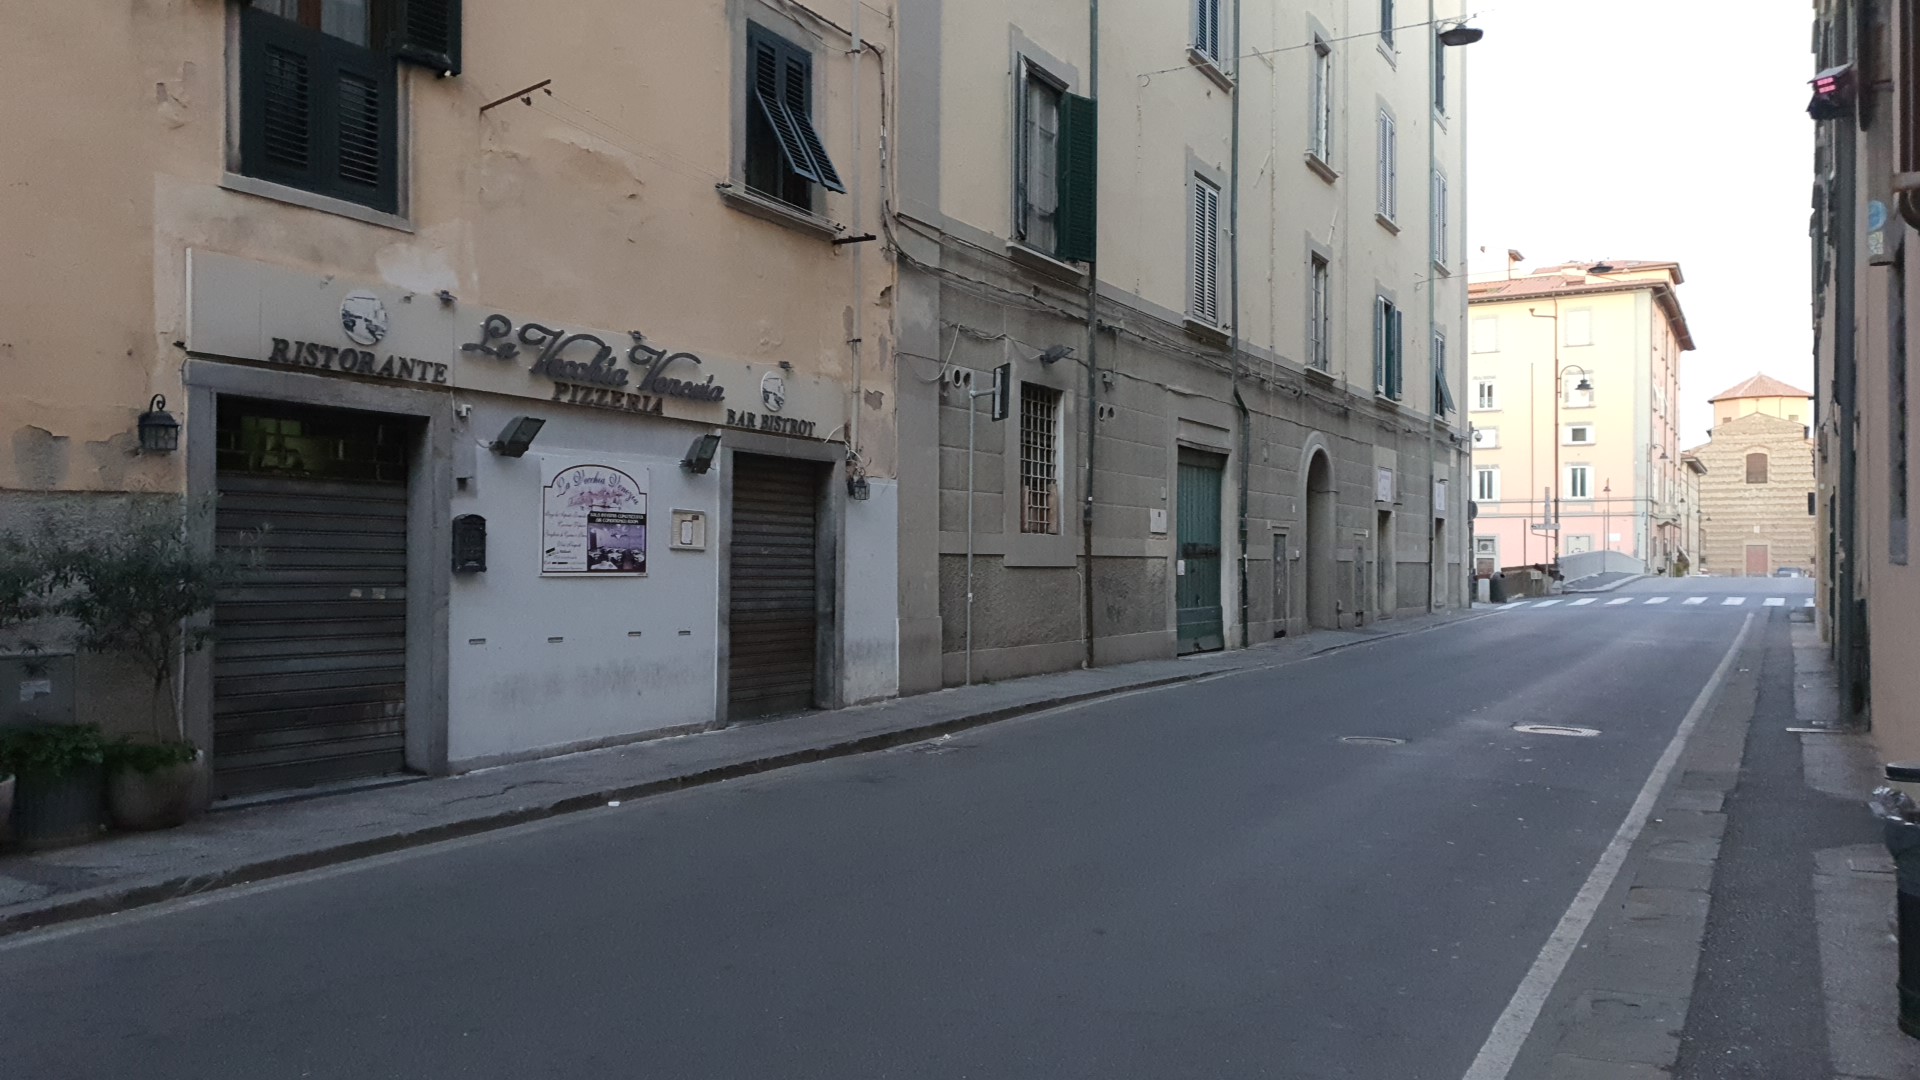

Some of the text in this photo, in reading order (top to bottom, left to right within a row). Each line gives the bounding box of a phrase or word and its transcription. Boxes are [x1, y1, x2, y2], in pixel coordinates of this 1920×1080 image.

[268, 337, 448, 384] RISTORANTE
[462, 314, 725, 401] La Vecchia Venezia
[551, 381, 664, 415] PIZZERIA
[726, 408, 757, 428] BAR
[572, 469, 606, 487] Vecchia
